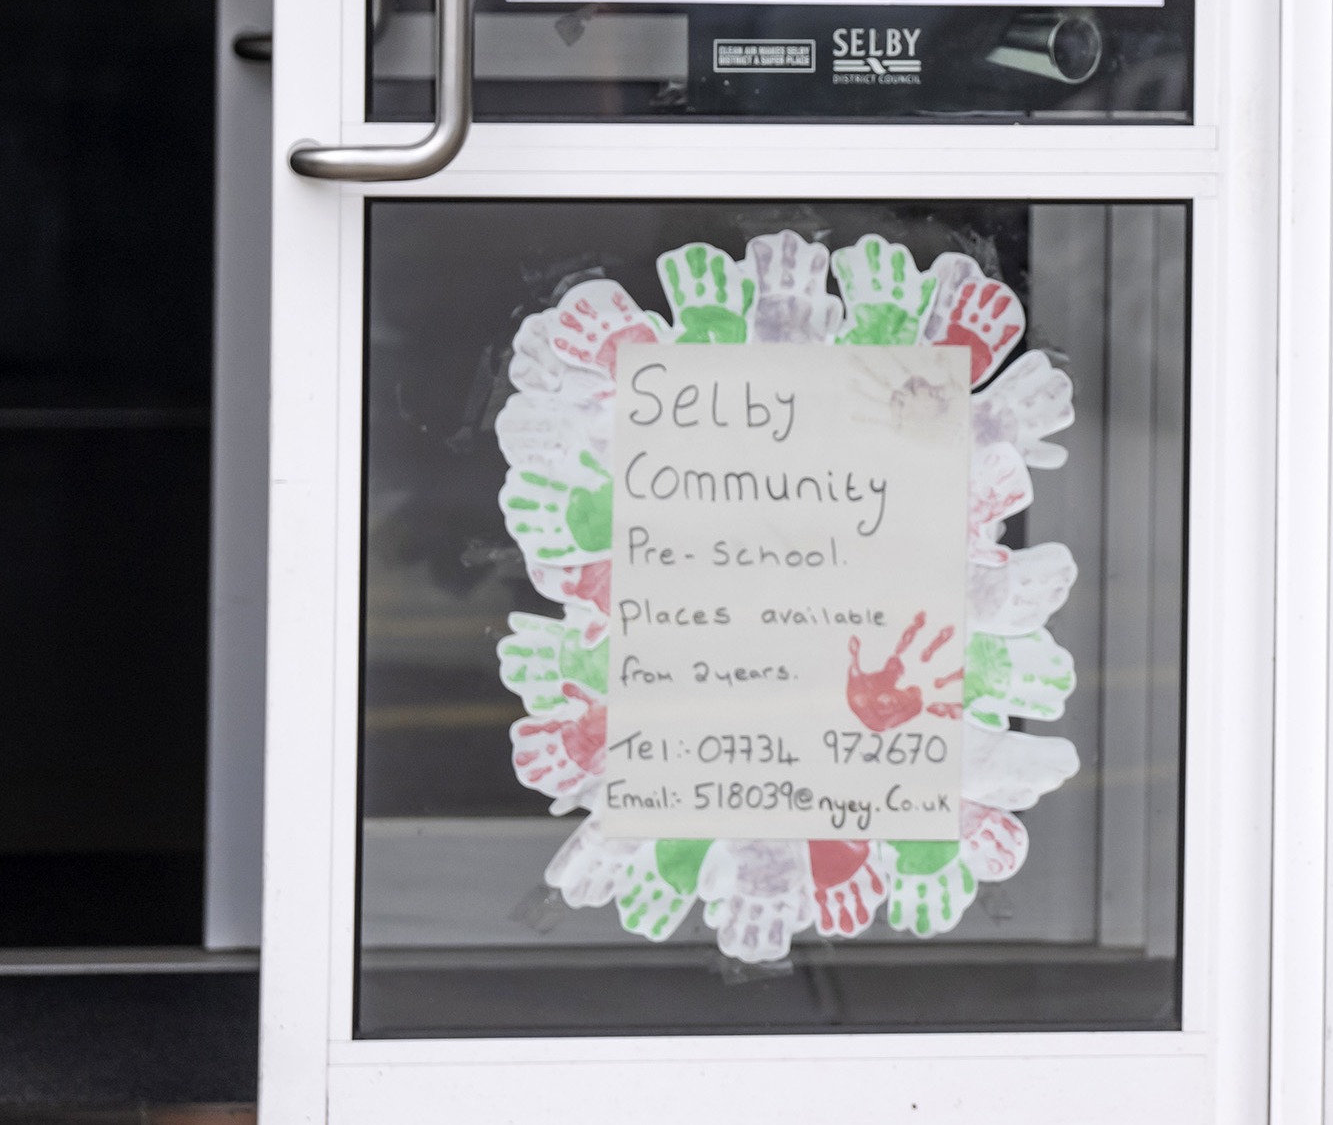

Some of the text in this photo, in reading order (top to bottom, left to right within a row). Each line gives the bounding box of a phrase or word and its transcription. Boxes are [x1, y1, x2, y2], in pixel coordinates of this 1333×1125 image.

[832, 27, 922, 57] SELBY
[832, 74, 921, 85] DISTRICT COUNCIL
[629, 363, 796, 442] Selby
[625, 450, 888, 537] Community
[760, 606, 888, 627] available
[619, 655, 674, 686] from
[697, 734, 800, 766] 07734
[822, 730, 948, 764] 972670
